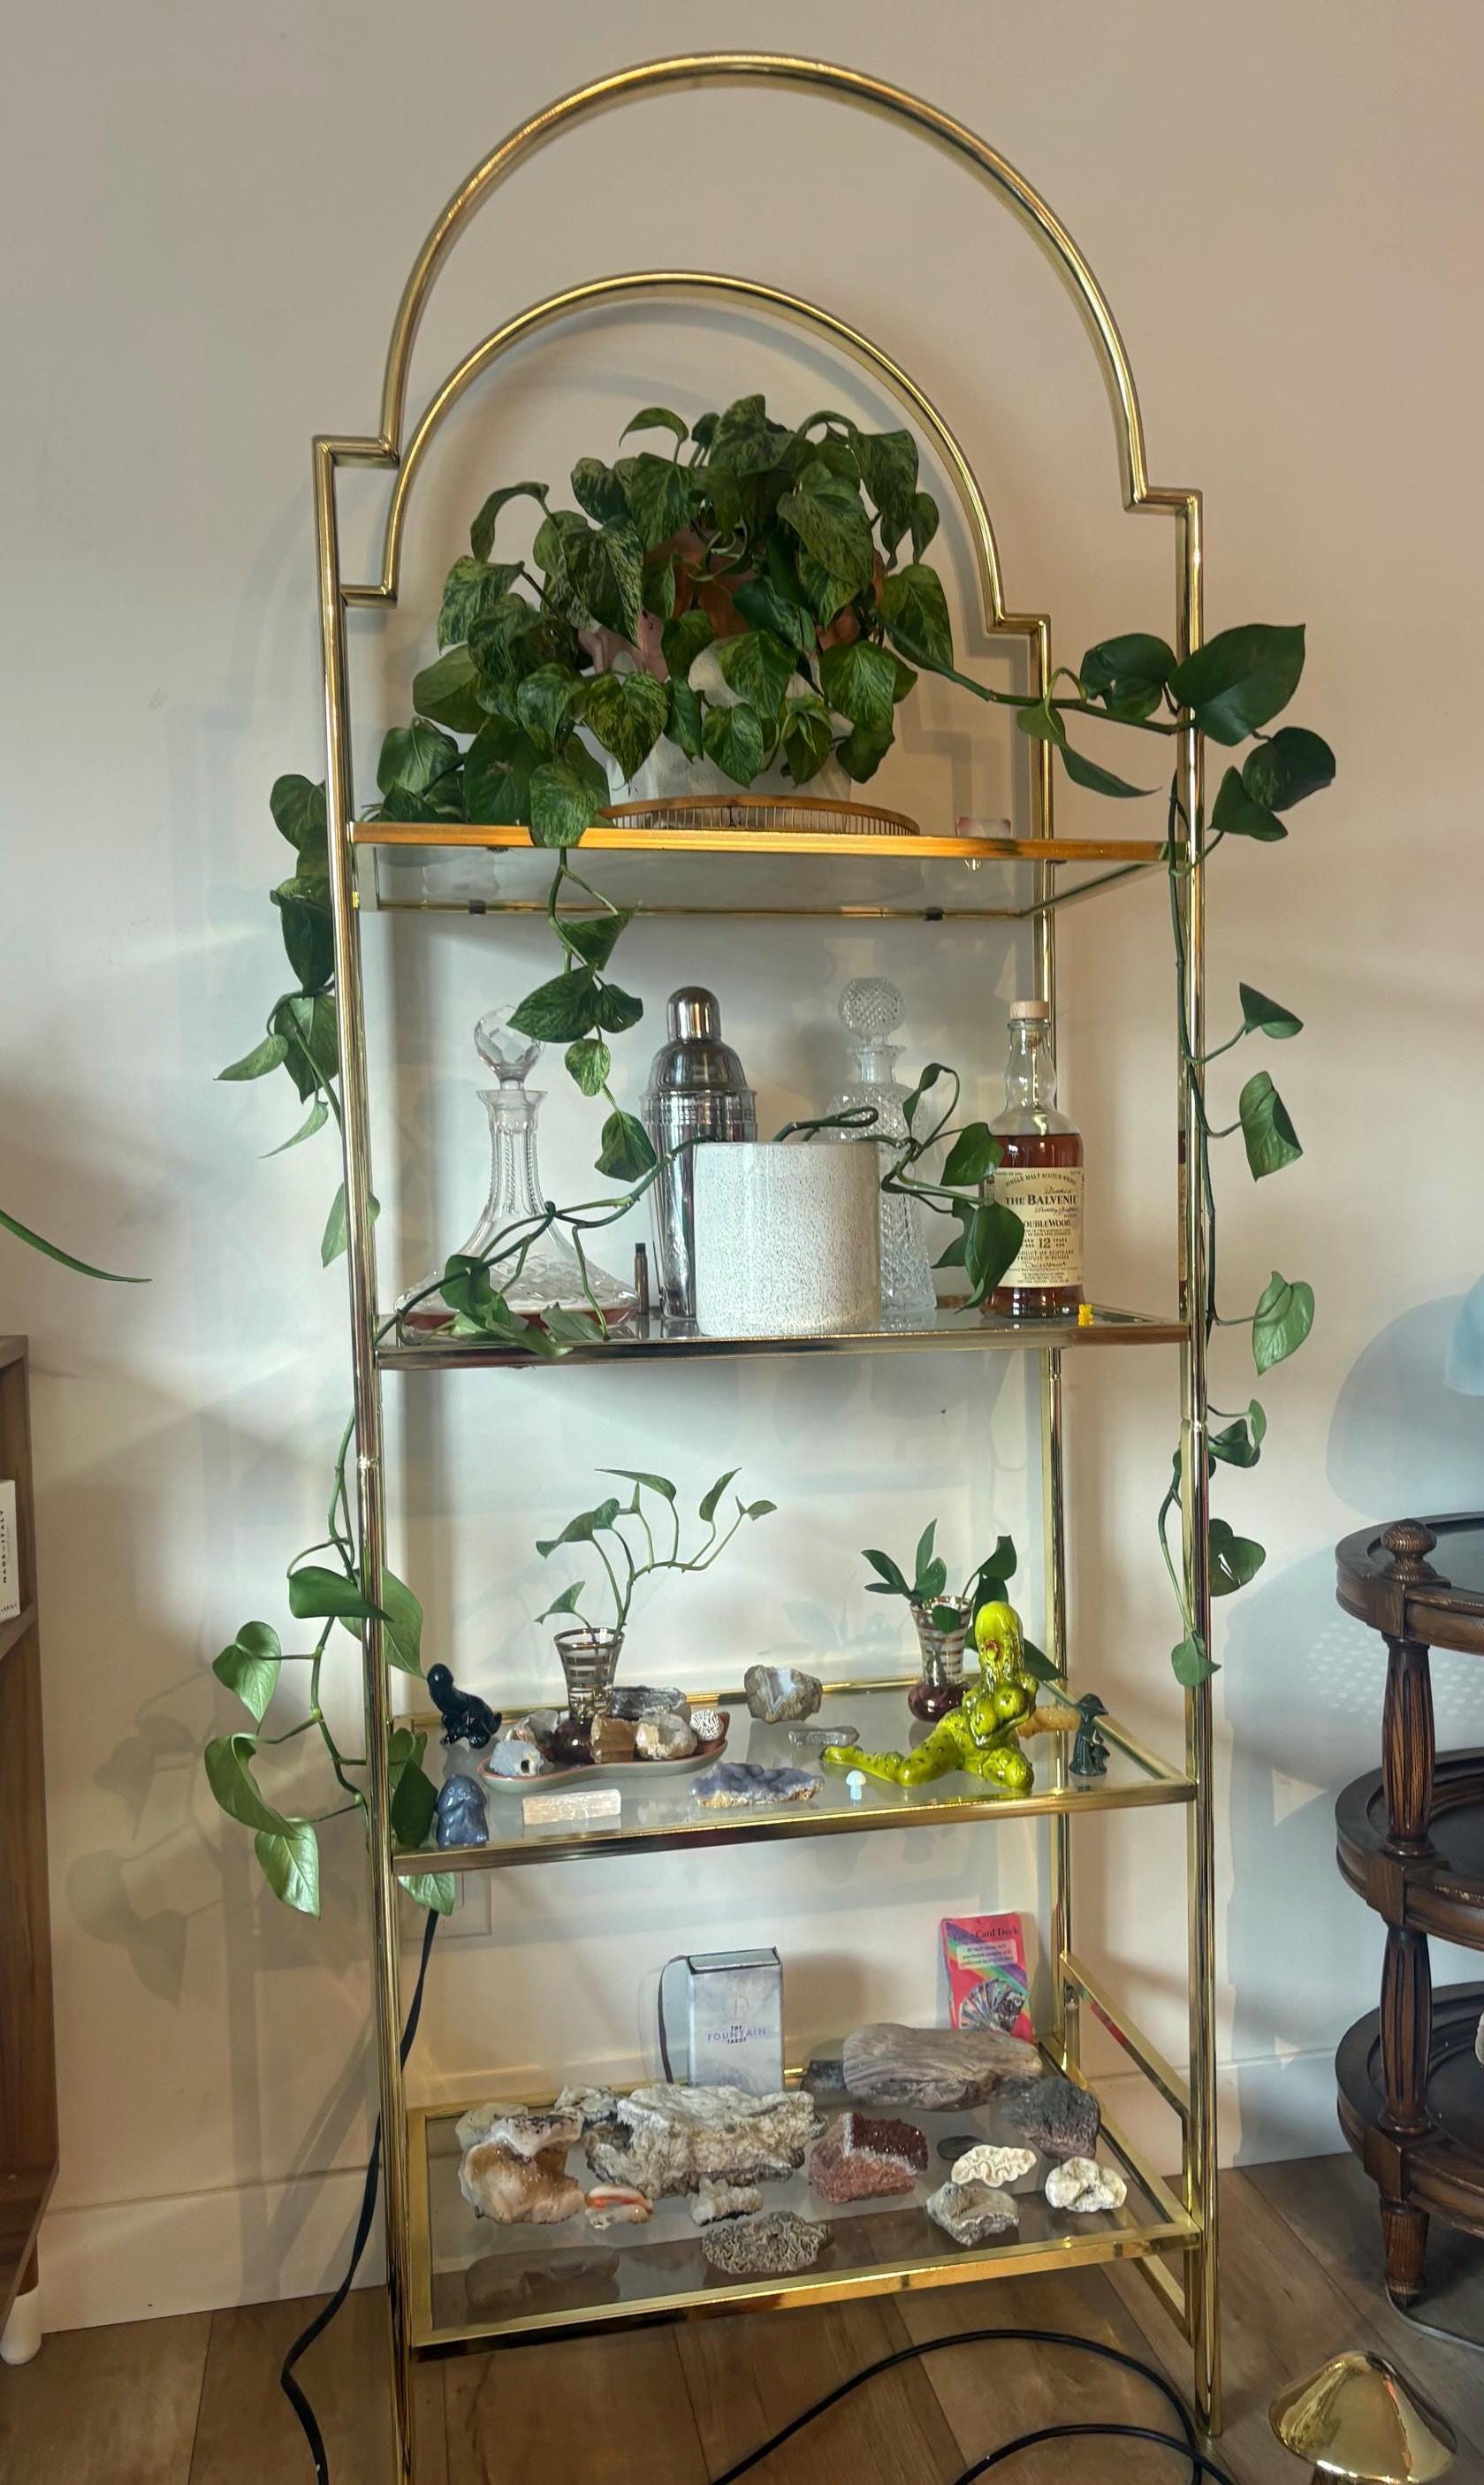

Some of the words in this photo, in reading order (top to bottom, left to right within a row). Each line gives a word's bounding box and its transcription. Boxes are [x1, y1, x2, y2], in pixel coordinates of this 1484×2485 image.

[1039, 1238, 1051, 1248] 12
[975, 1929, 995, 1939] Card
[707, 2027, 766, 2041] FOUNTAIN
